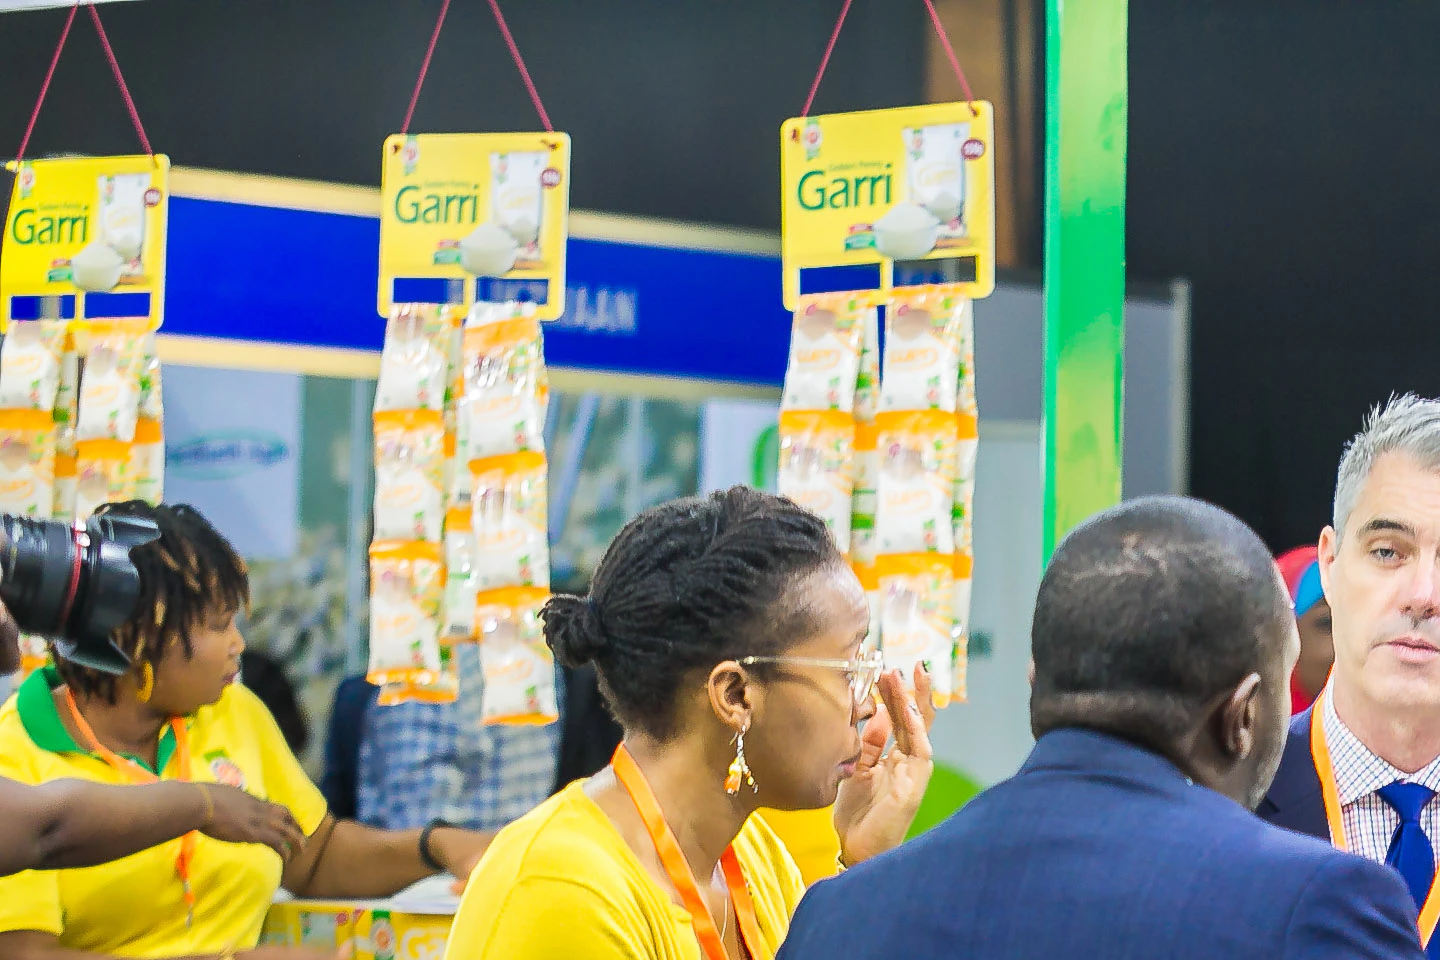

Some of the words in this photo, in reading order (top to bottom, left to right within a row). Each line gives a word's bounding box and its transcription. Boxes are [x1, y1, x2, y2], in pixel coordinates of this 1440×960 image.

[394, 183, 480, 225] Garri
[797, 163, 893, 211] Garri
[12, 205, 90, 246] Garri
